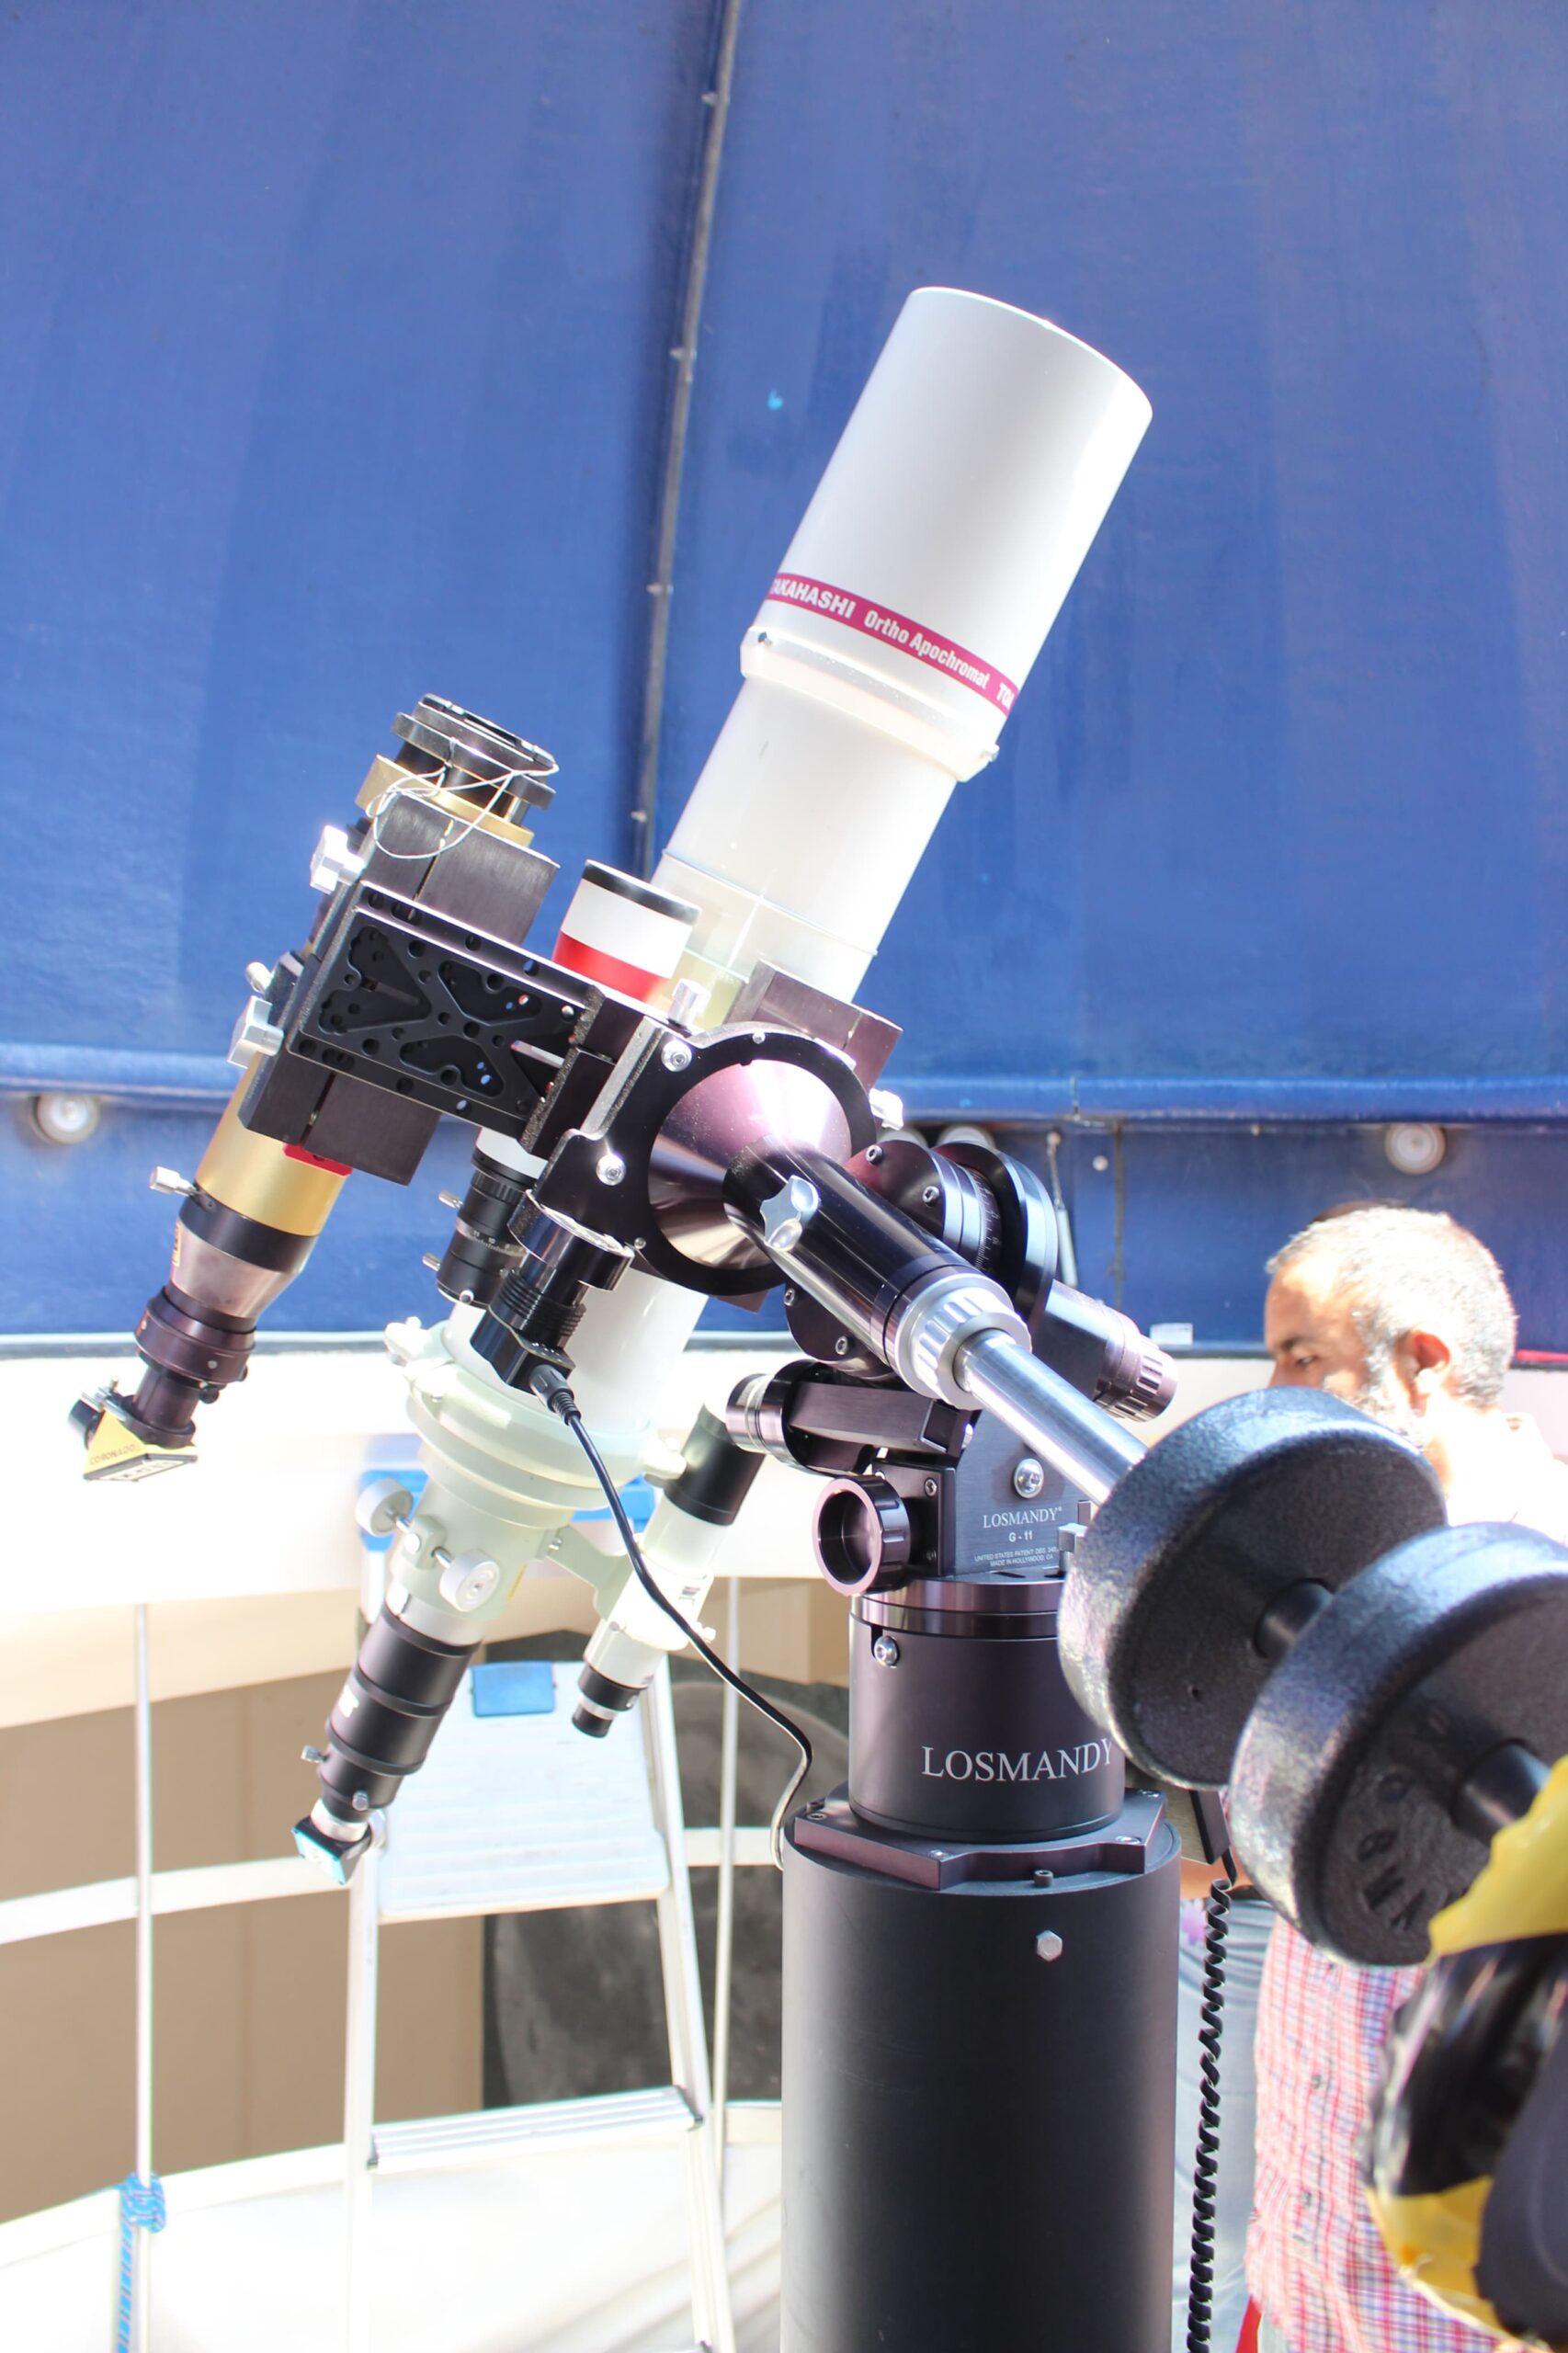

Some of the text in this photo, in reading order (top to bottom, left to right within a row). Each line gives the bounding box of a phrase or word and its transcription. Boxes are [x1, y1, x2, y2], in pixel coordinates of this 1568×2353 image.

[864, 609, 910, 644] Ortho
[909, 632, 991, 689] Apochromat
[90, 1444, 136, 1465] CORONADO
[921, 1737, 1113, 1782] LOSMANDY
